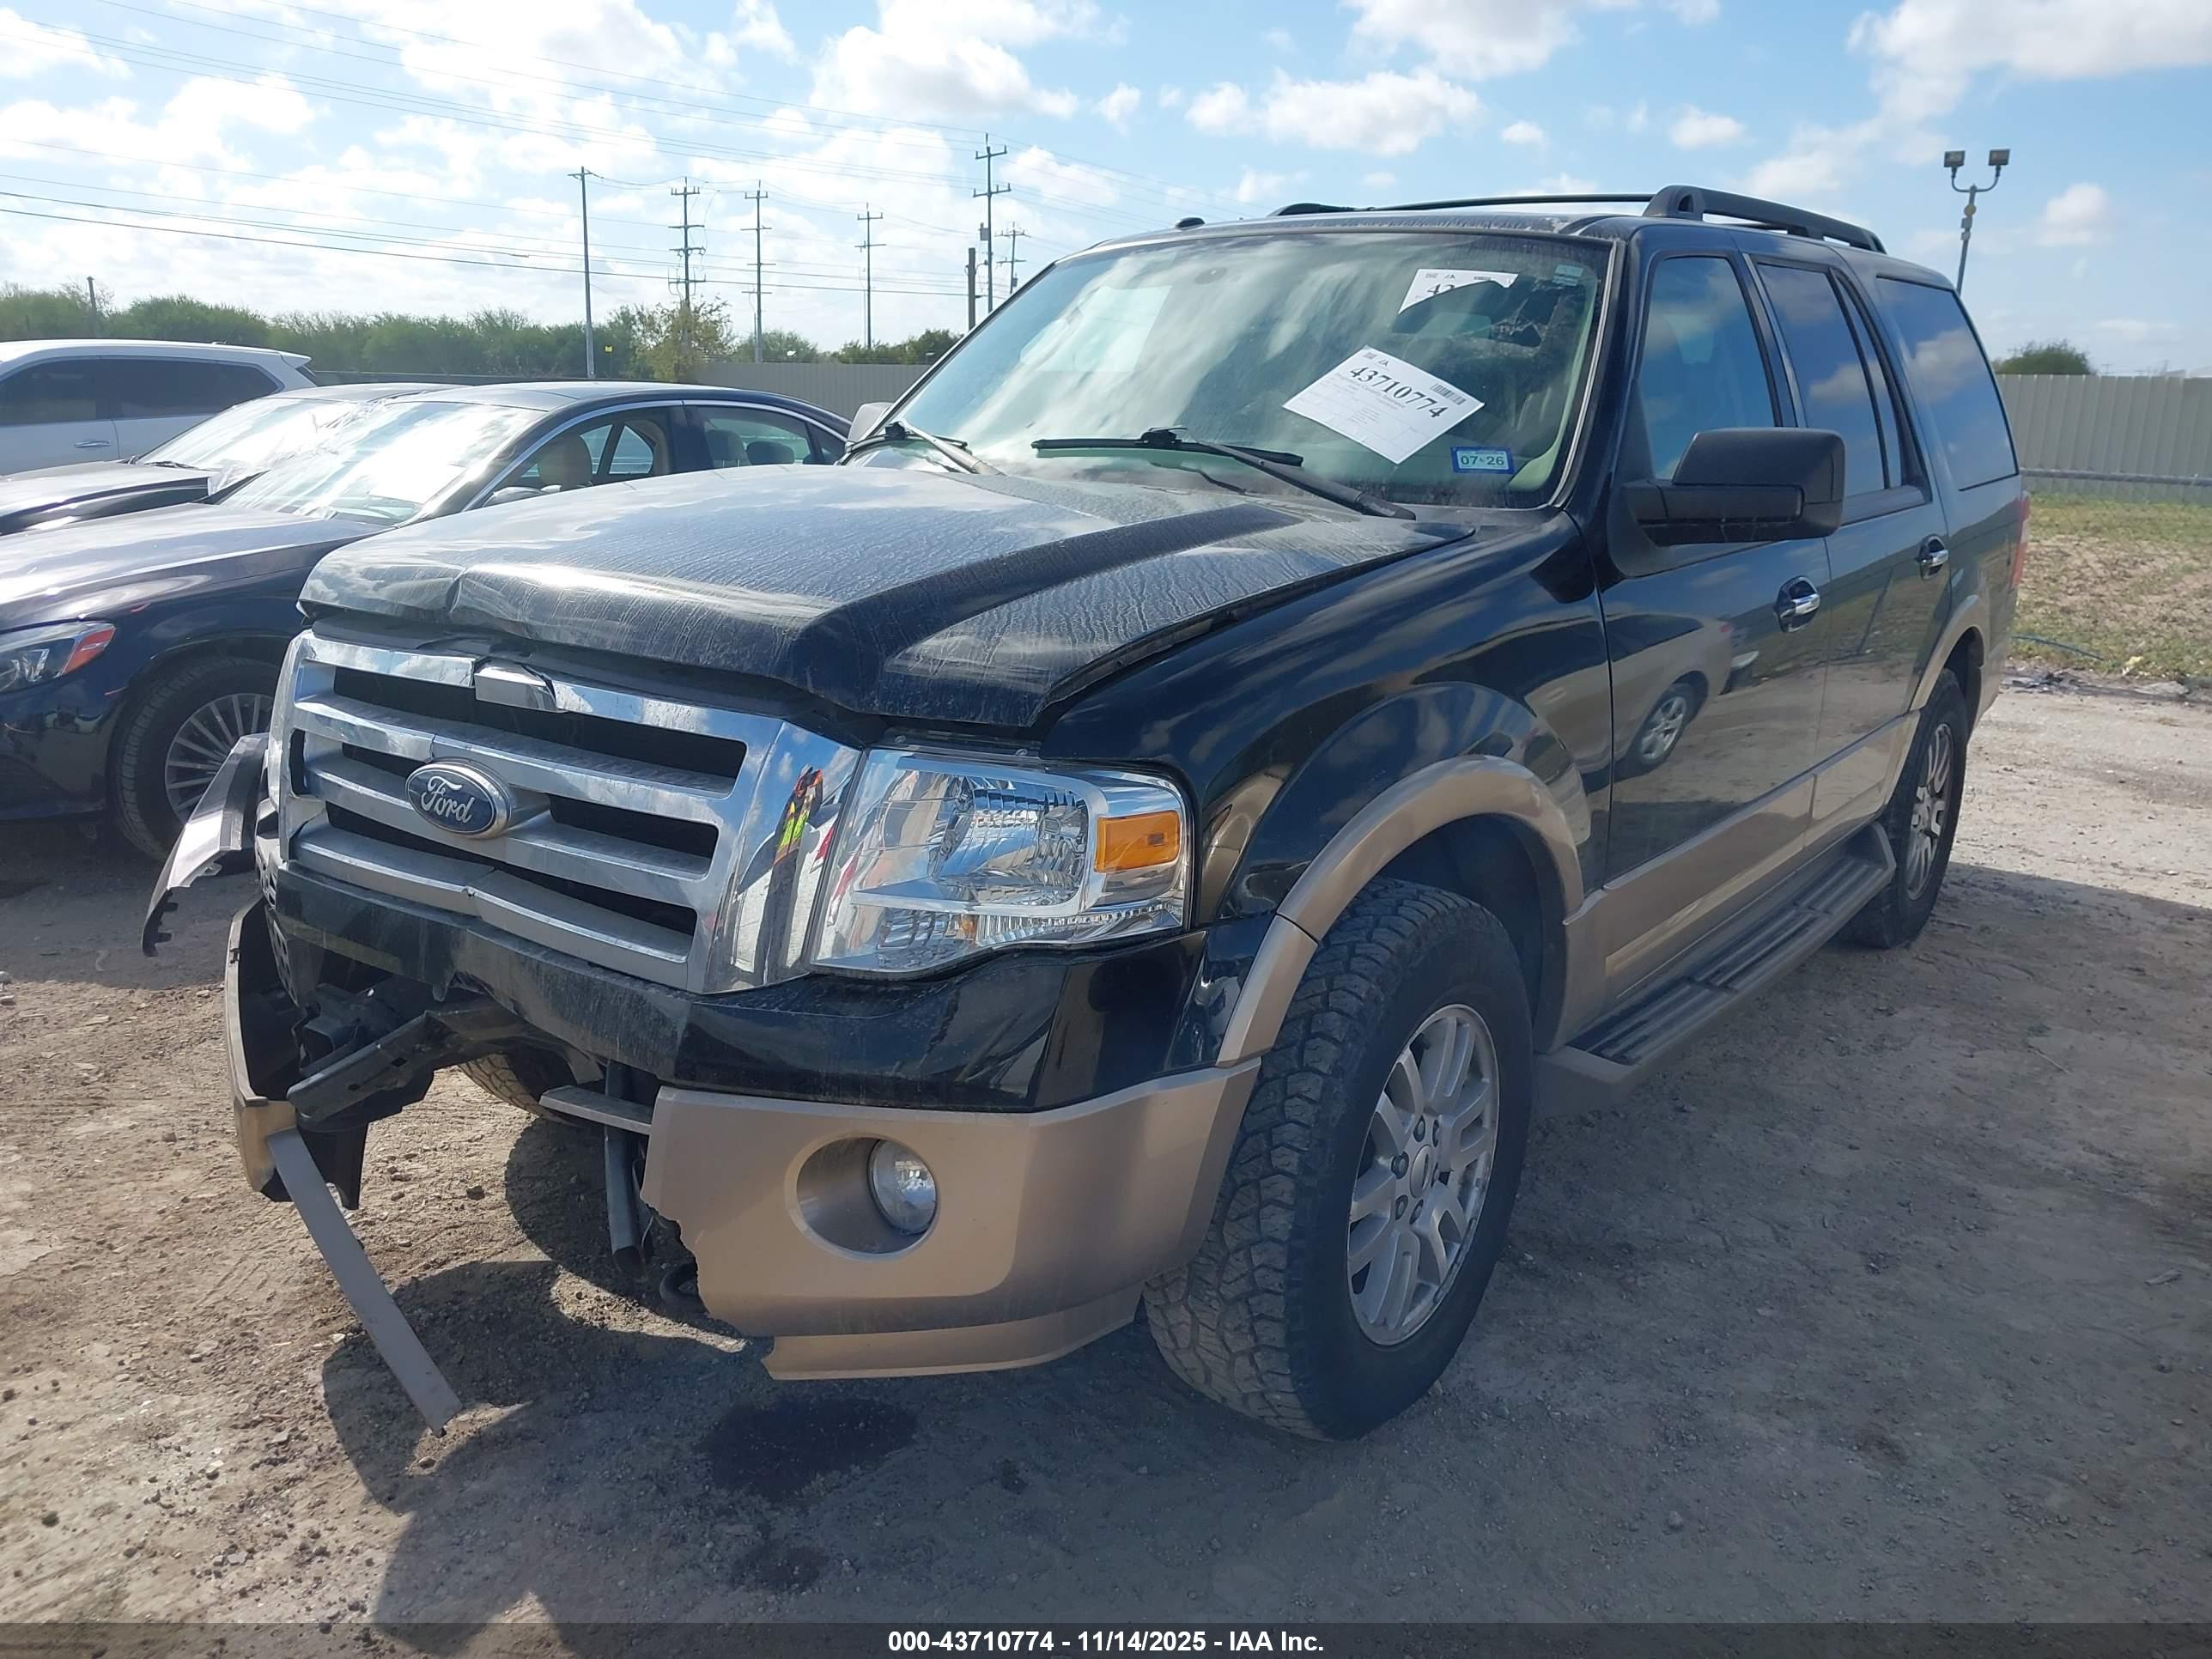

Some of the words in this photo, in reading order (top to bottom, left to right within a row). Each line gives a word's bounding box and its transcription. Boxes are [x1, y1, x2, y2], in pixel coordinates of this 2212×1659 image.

[1350, 367, 1449, 418] 43710774
[1461, 456, 1479, 465] 07
[1486, 456, 1504, 465] 26
[421, 776, 475, 823] Ford
